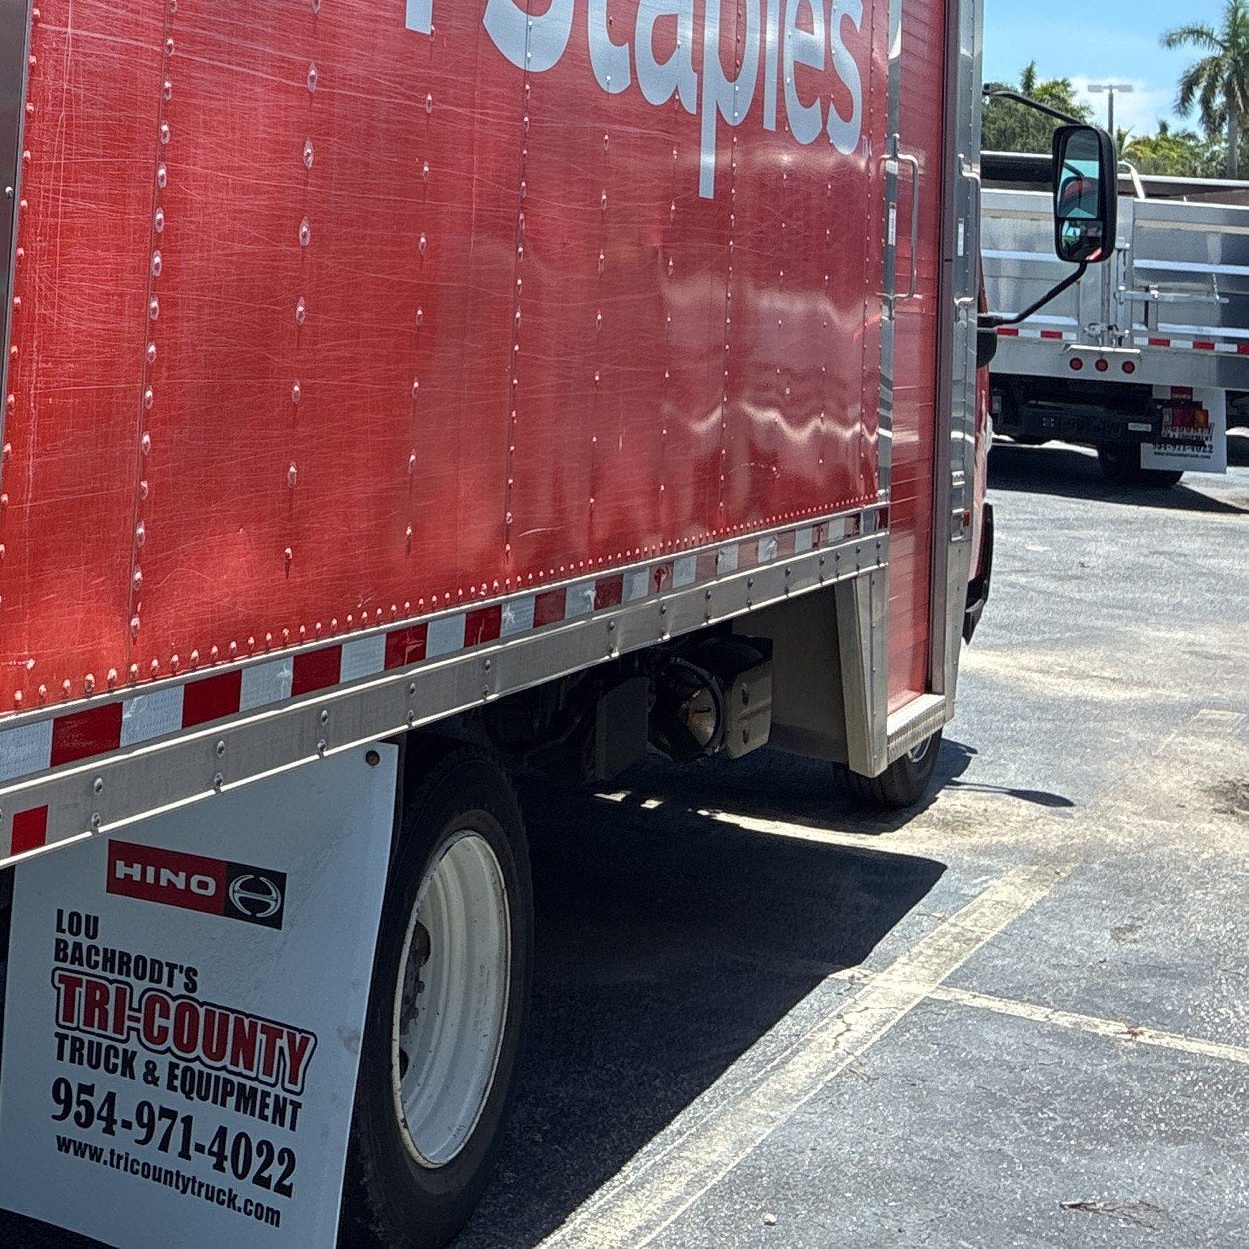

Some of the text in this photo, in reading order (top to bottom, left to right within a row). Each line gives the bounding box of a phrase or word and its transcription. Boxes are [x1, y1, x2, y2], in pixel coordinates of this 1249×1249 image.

[55, 908, 100, 940] LOU
[114, 859, 217, 898] HINO
[53, 938, 199, 994] BACHRODT'S
[52, 968, 317, 1094] TRI-COUNTY
[54, 1031, 303, 1133] TRUCK & EQUIPMENT
[51, 1075, 297, 1199] 954-971-4022
[55, 1134, 282, 1228] www.tricountytruck.com
